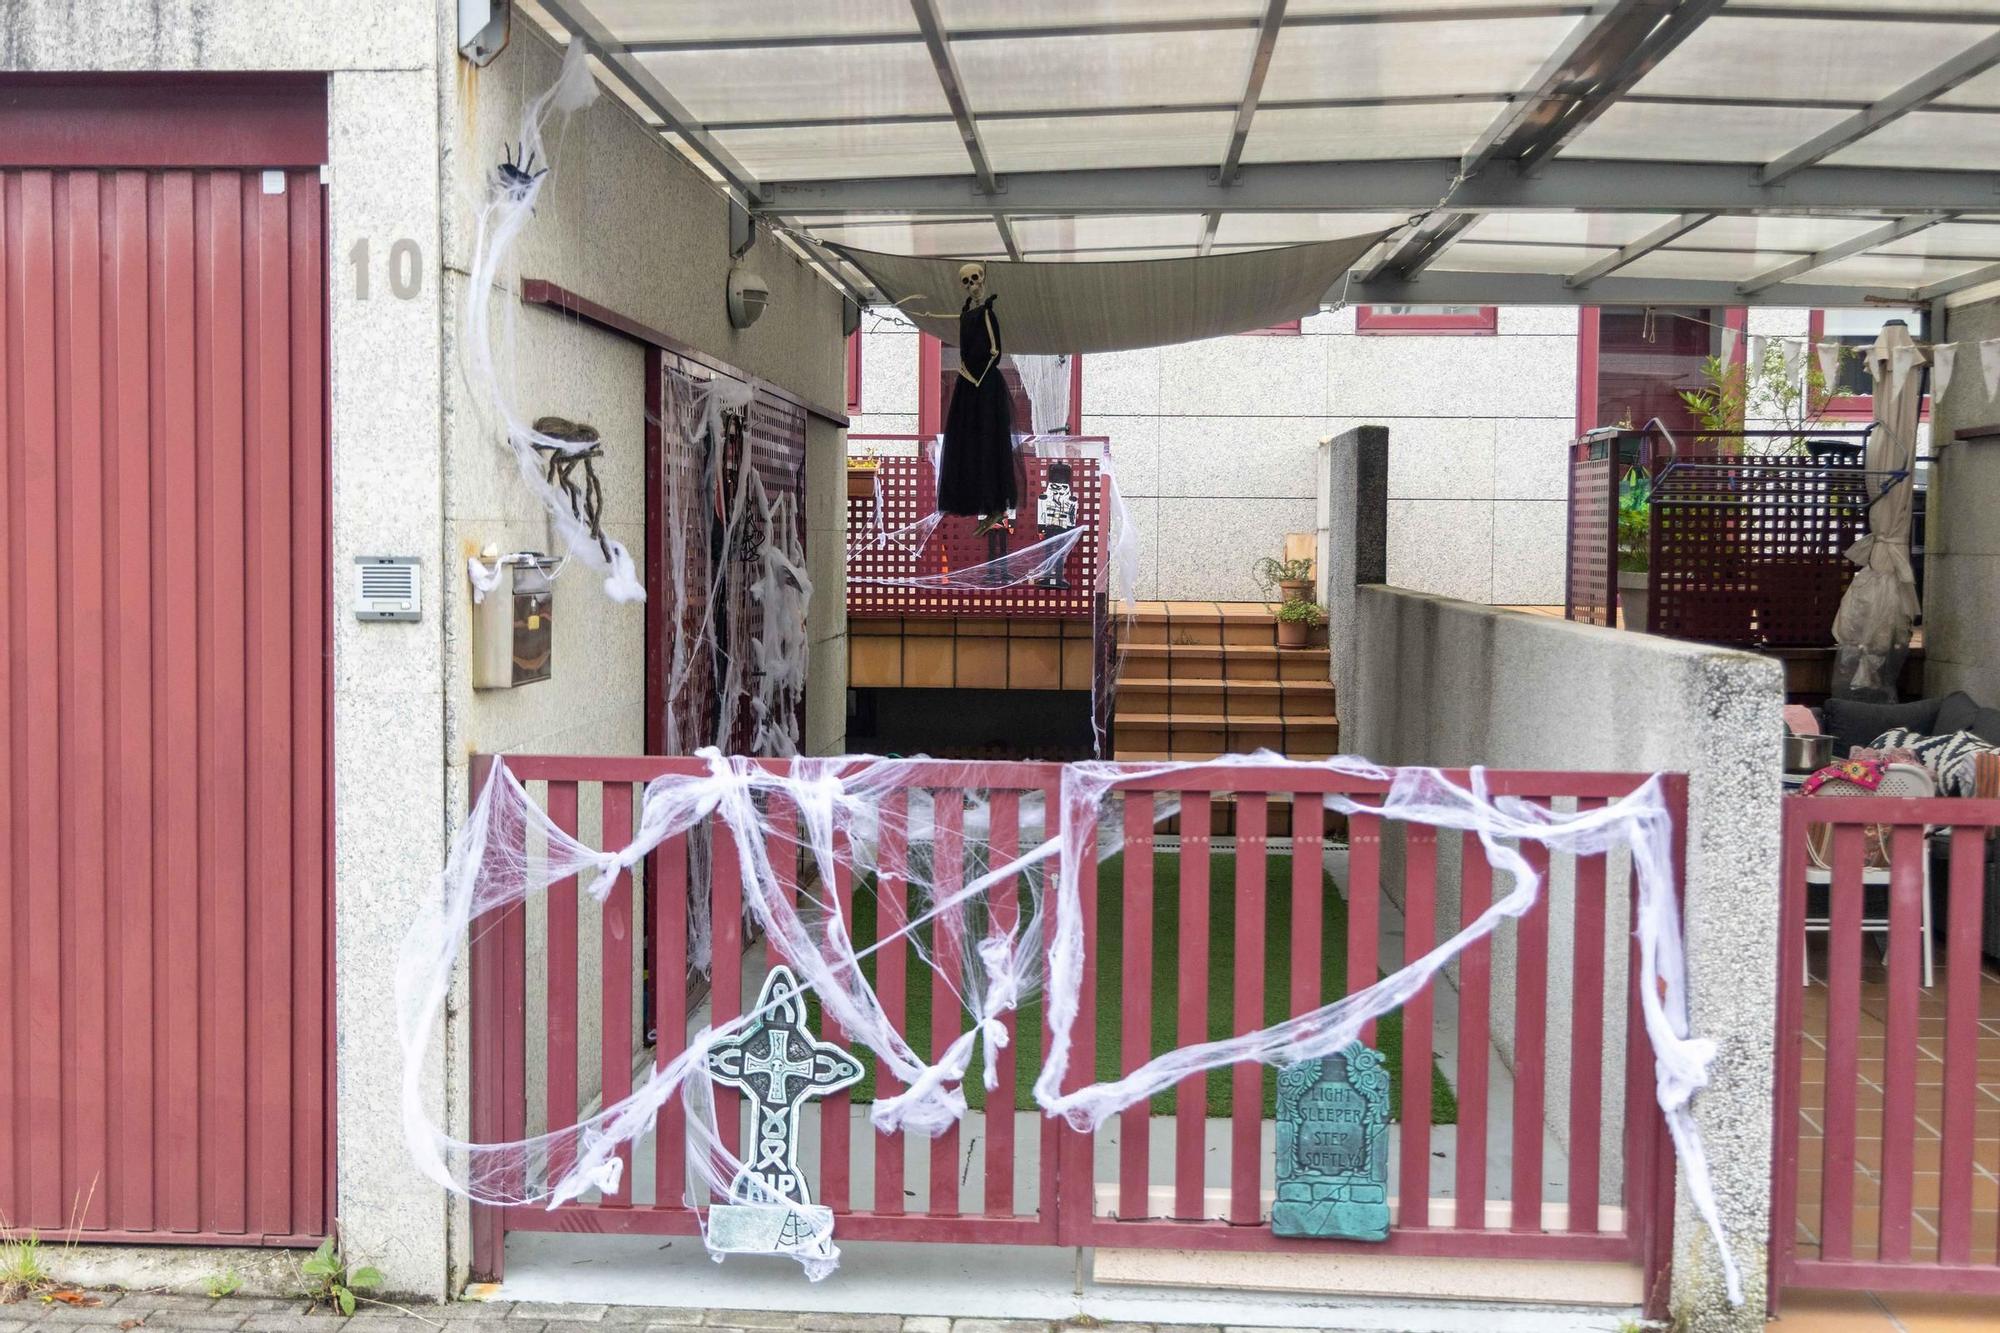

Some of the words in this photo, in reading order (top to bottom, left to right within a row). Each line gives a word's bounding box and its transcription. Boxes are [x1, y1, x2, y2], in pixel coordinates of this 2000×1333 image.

[349, 238, 422, 300] 10
[1311, 1087, 1353, 1102] LIGHT
[1301, 1107, 1361, 1123] SLEEPER
[1314, 1131, 1348, 1146] STEP
